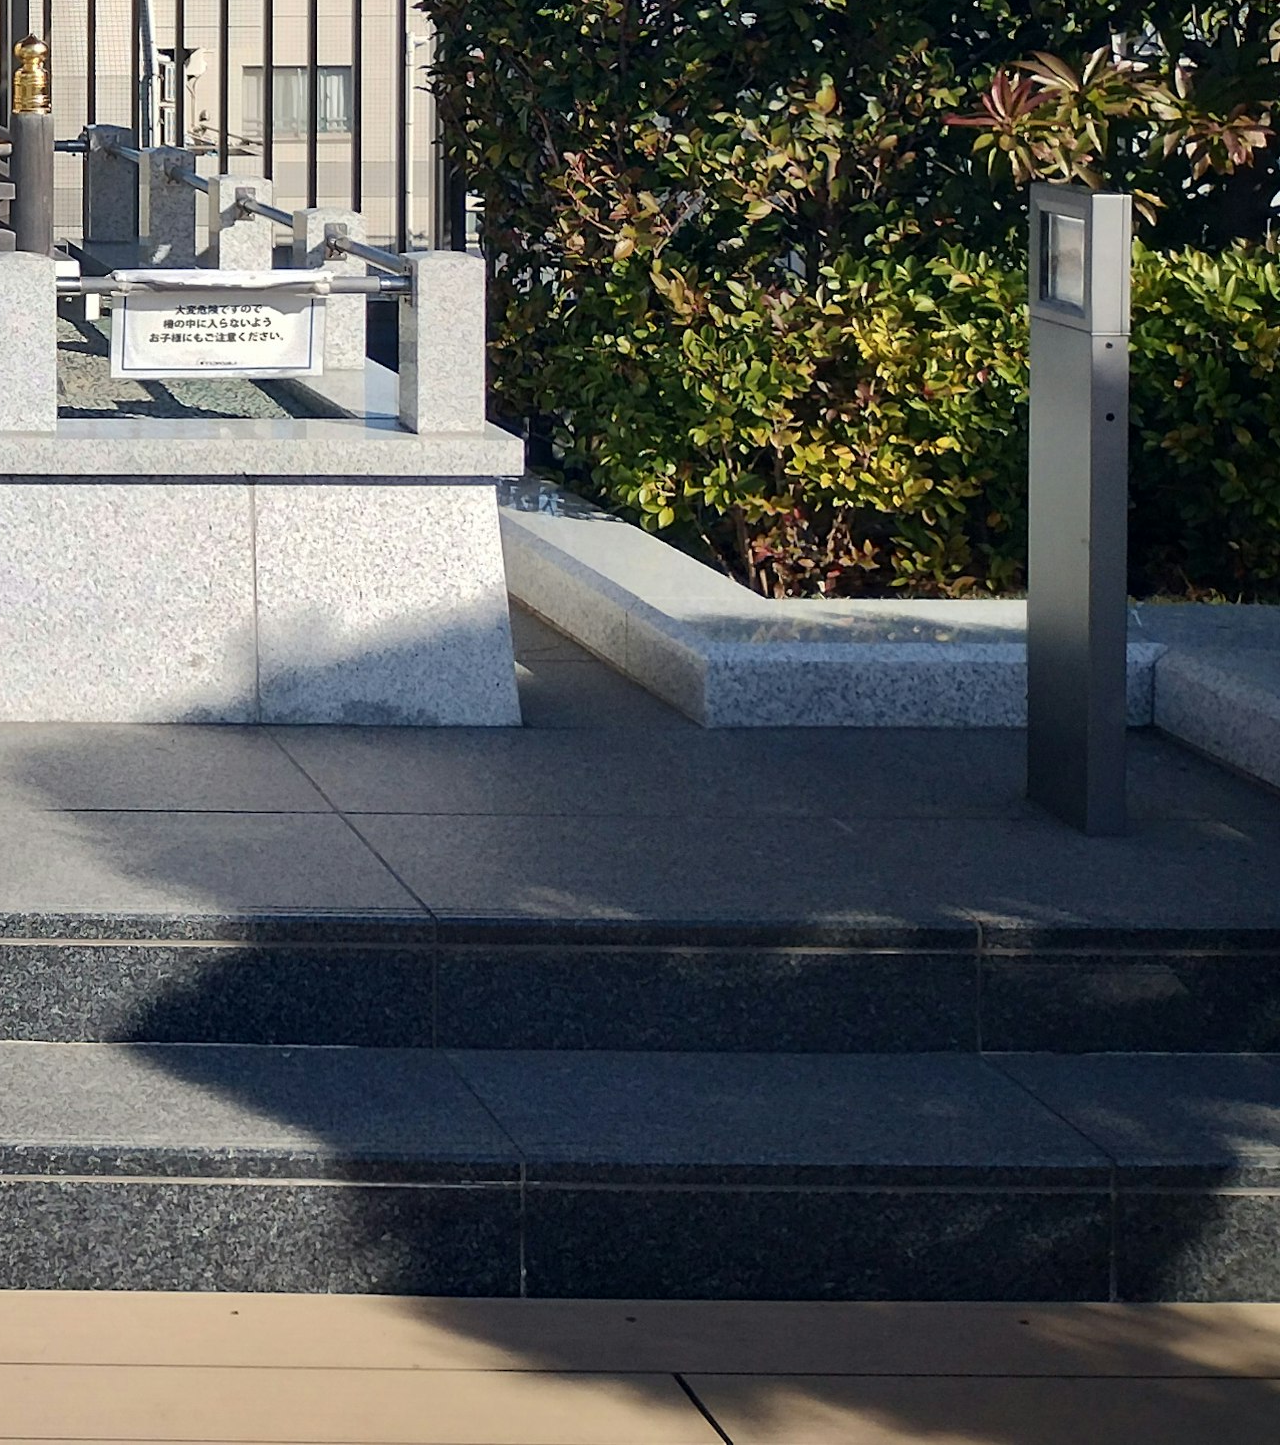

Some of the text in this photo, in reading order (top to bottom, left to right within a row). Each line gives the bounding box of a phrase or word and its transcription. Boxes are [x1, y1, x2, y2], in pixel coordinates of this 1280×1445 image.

[175, 304, 263, 315] 大変危険ですので
[149, 332, 284, 343] お子様にもご注意ください。
